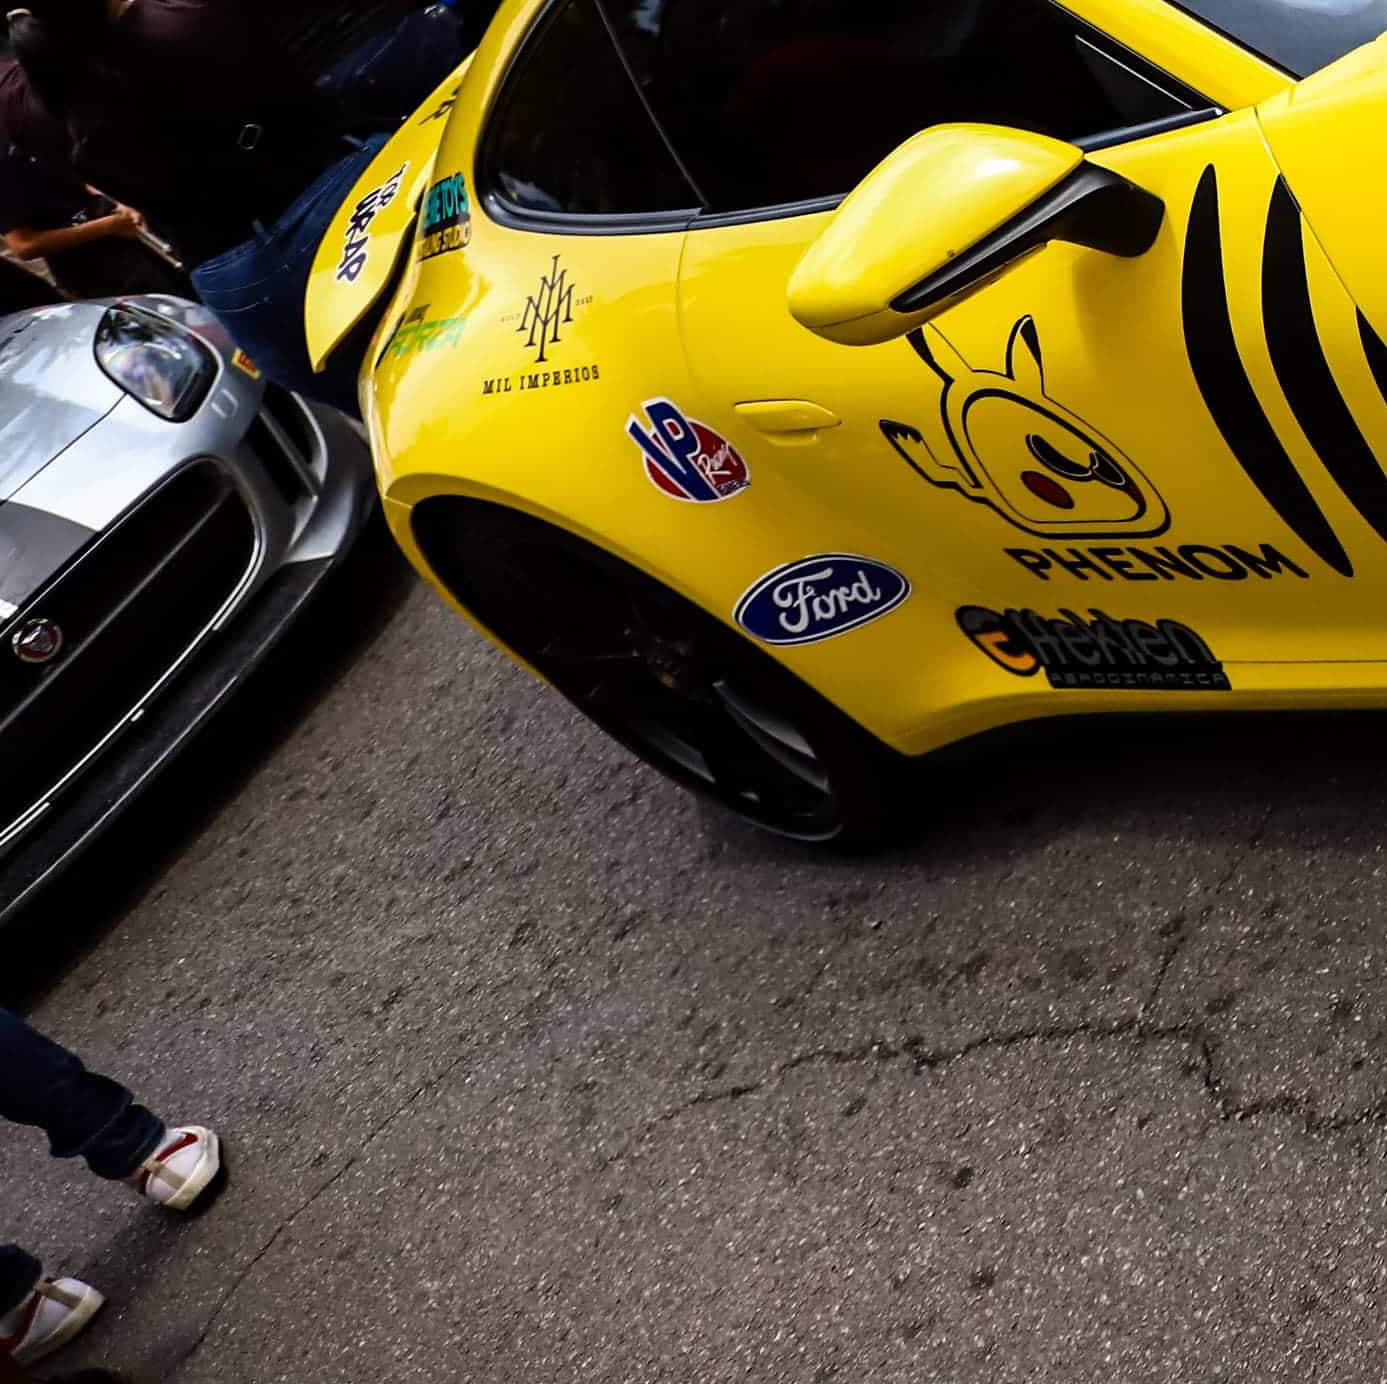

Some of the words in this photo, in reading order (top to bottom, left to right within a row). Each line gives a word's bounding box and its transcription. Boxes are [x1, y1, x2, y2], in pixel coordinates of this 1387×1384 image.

[482, 377, 512, 395] MIL
[519, 364, 600, 391] IMPERIOS
[1004, 543, 1309, 582] PHENOM
[771, 566, 882, 634] Ford
